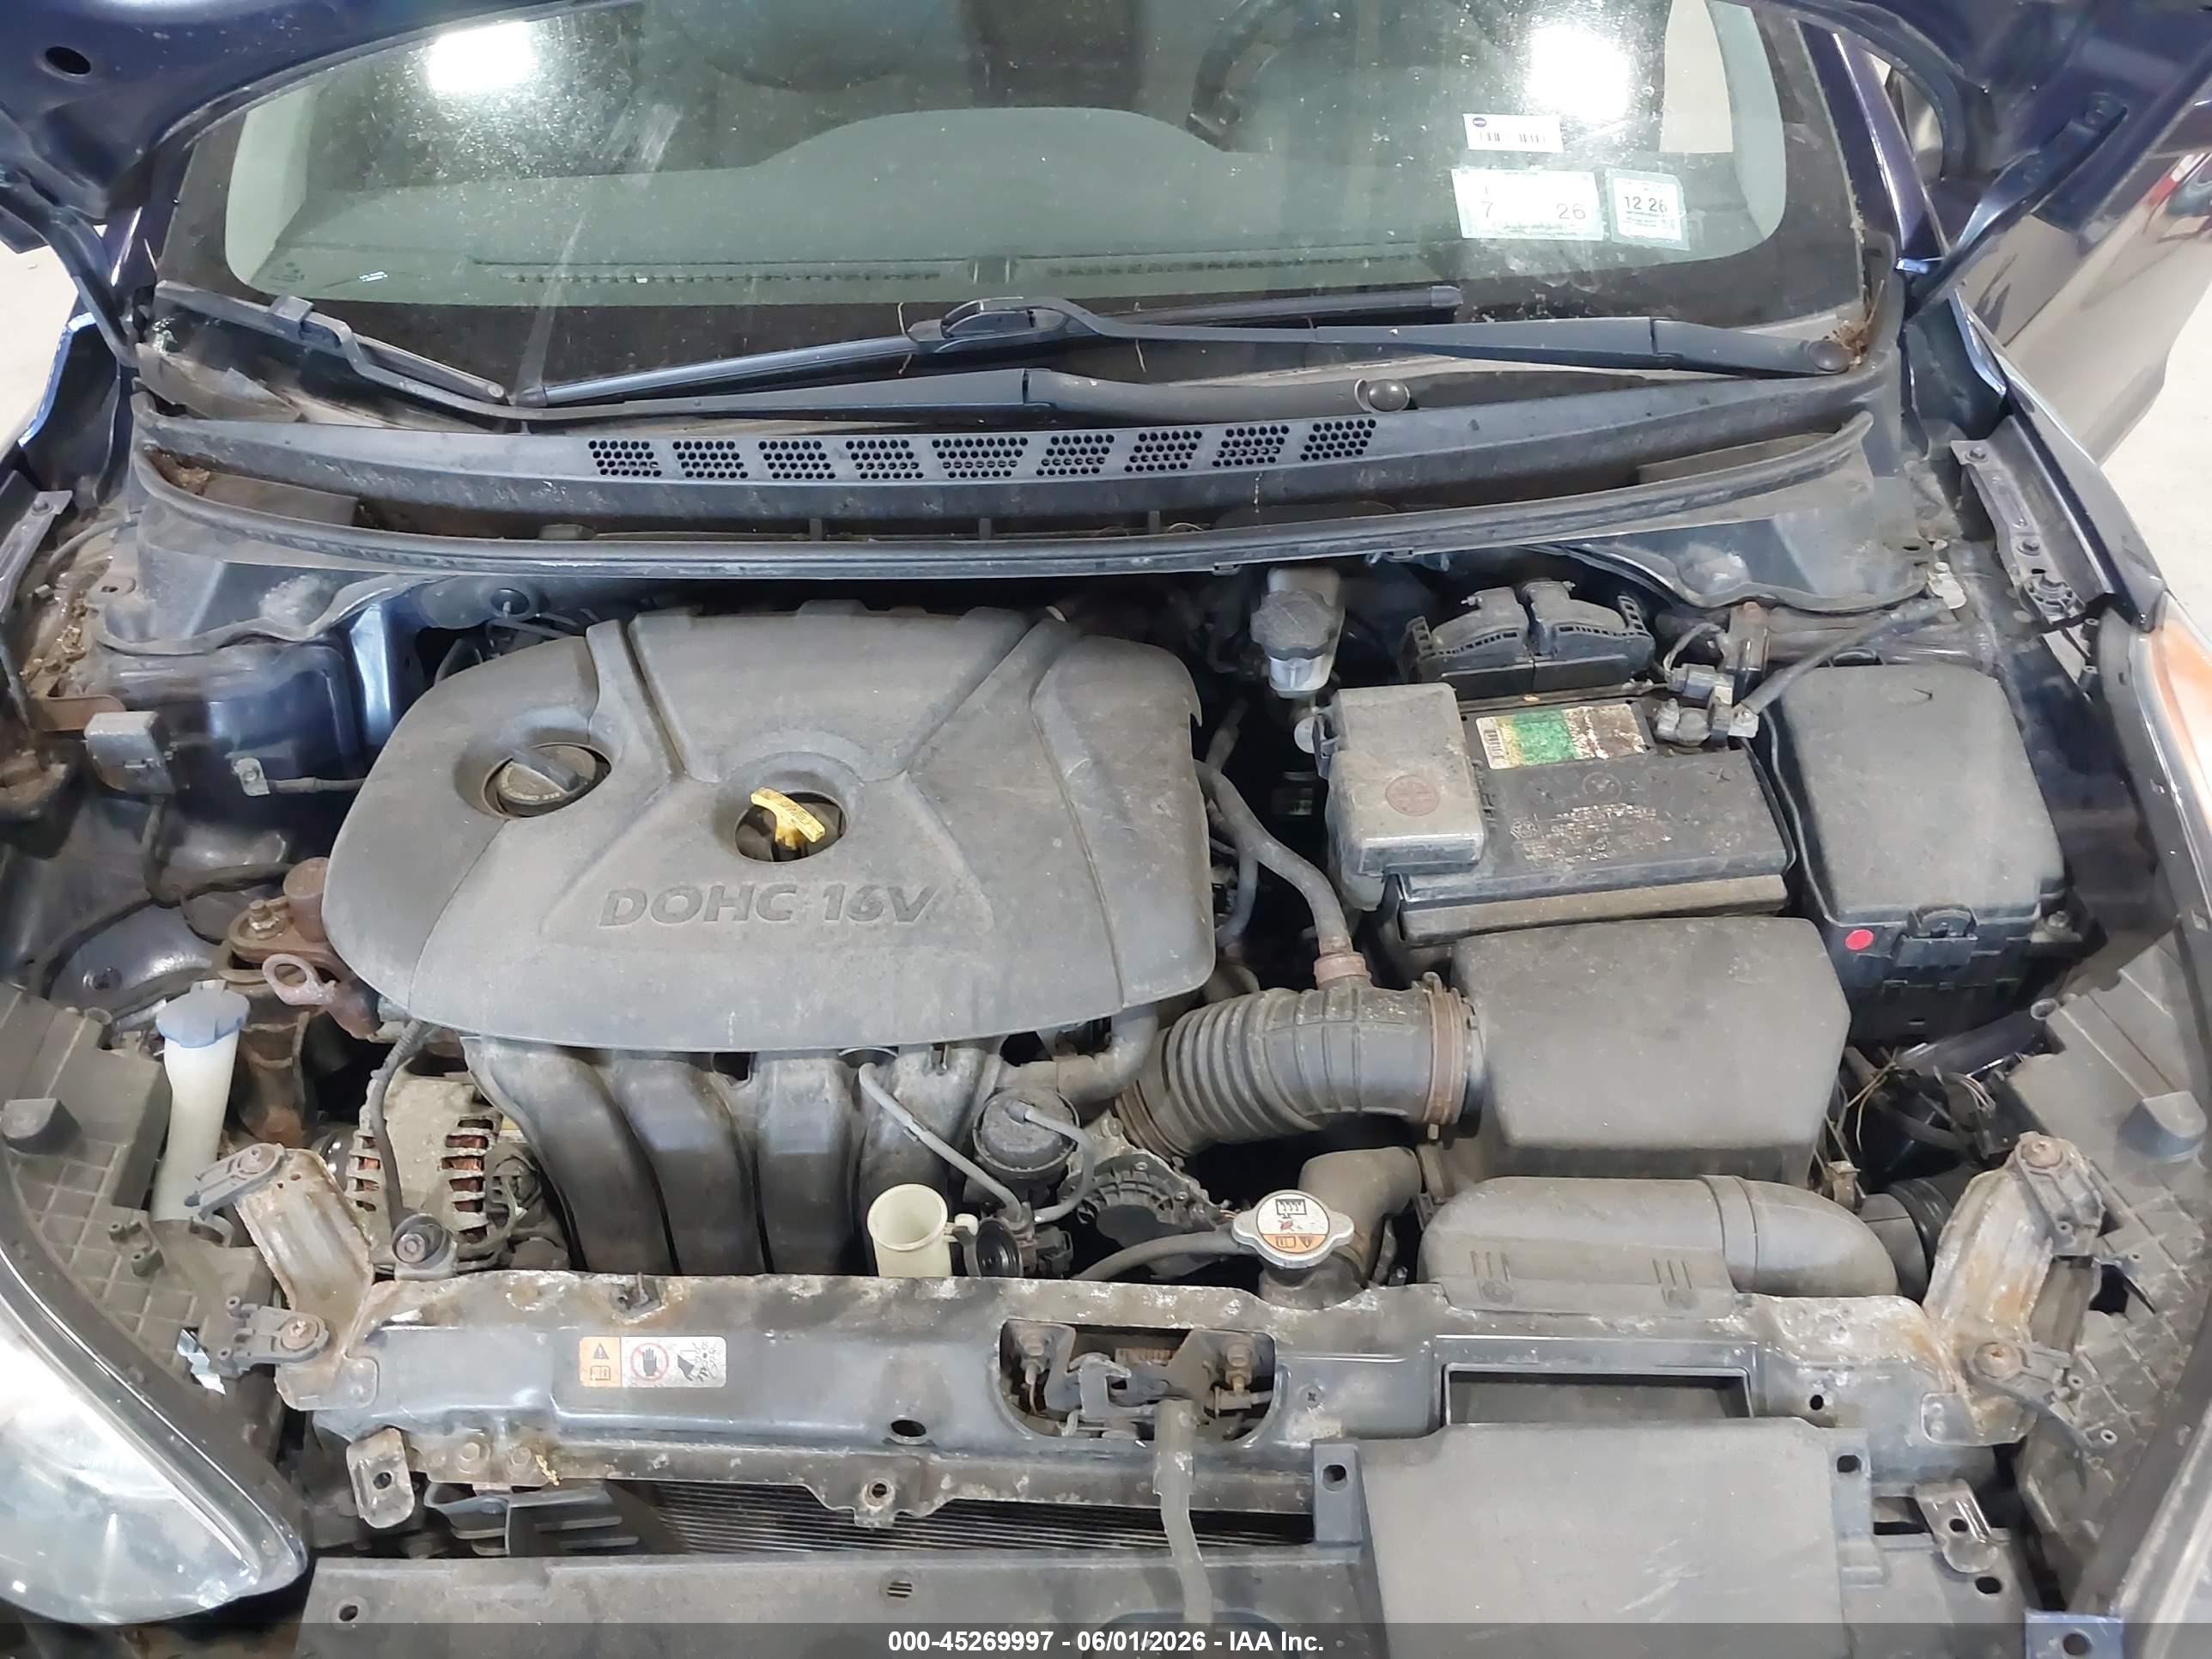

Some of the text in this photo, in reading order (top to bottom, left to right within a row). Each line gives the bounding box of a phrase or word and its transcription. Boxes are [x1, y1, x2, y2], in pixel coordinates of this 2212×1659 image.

[1480, 200, 1586, 220] 7 26
[1624, 196, 1668, 213] 12 26
[599, 883, 939, 927] DOHC 16V
